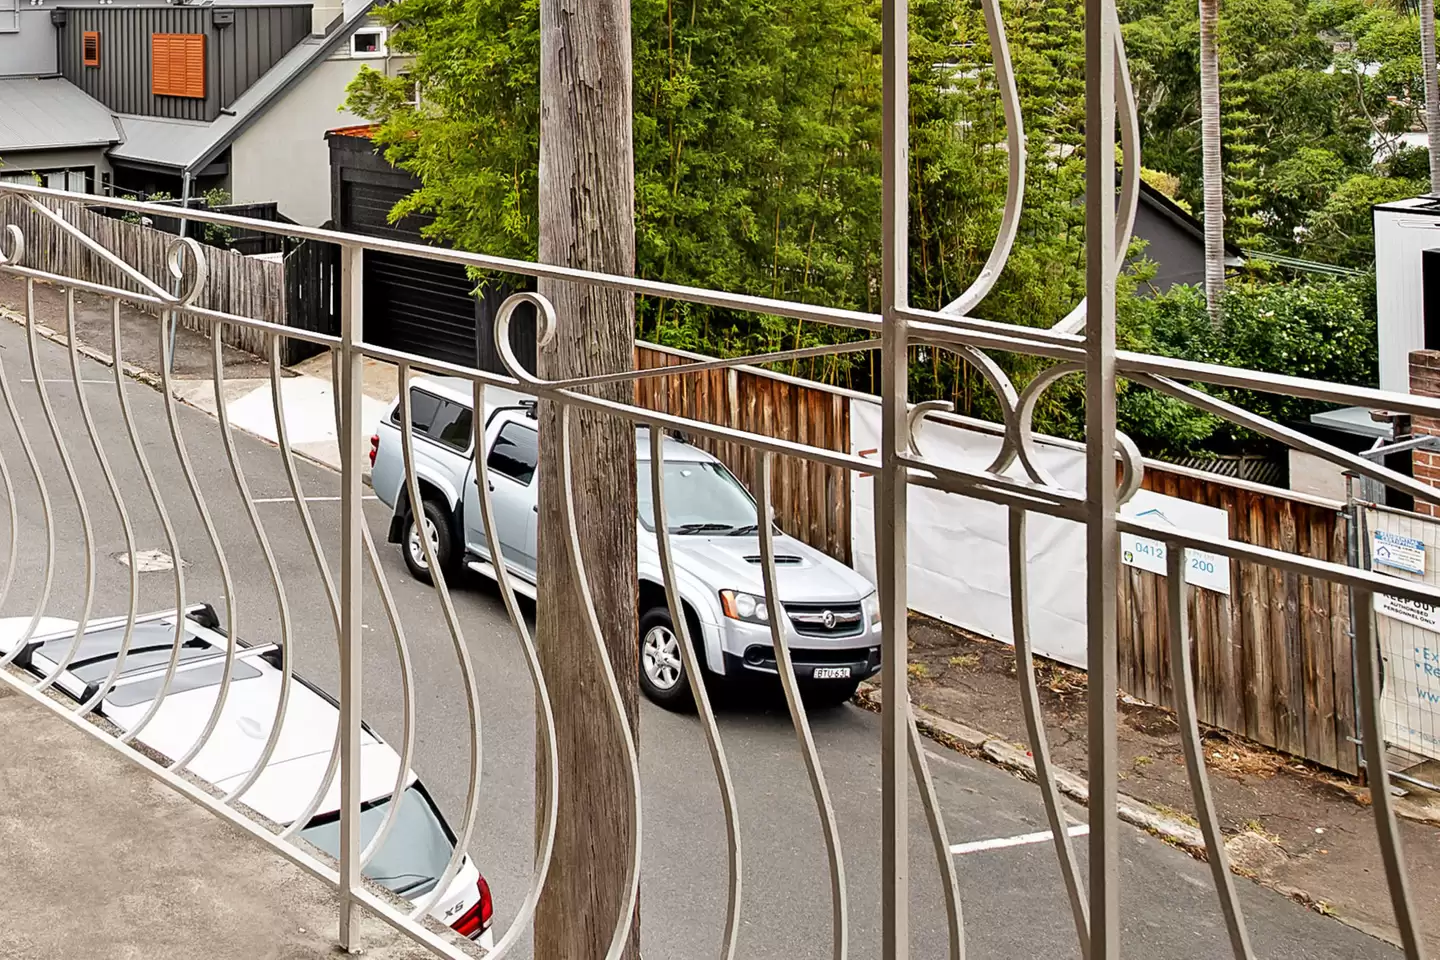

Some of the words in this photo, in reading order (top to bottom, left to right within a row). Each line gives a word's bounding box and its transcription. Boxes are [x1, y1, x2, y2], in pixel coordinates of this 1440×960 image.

[1135, 542, 1163, 559] 0412
[1192, 558, 1214, 573] 200
[1383, 604, 1419, 620] PERSONNEL
[1420, 616, 1436, 625] ONLY
[1390, 601, 1429, 617] AUTHORISED
[1413, 600, 1436, 613] OUT
[443, 900, 464, 921] X5
